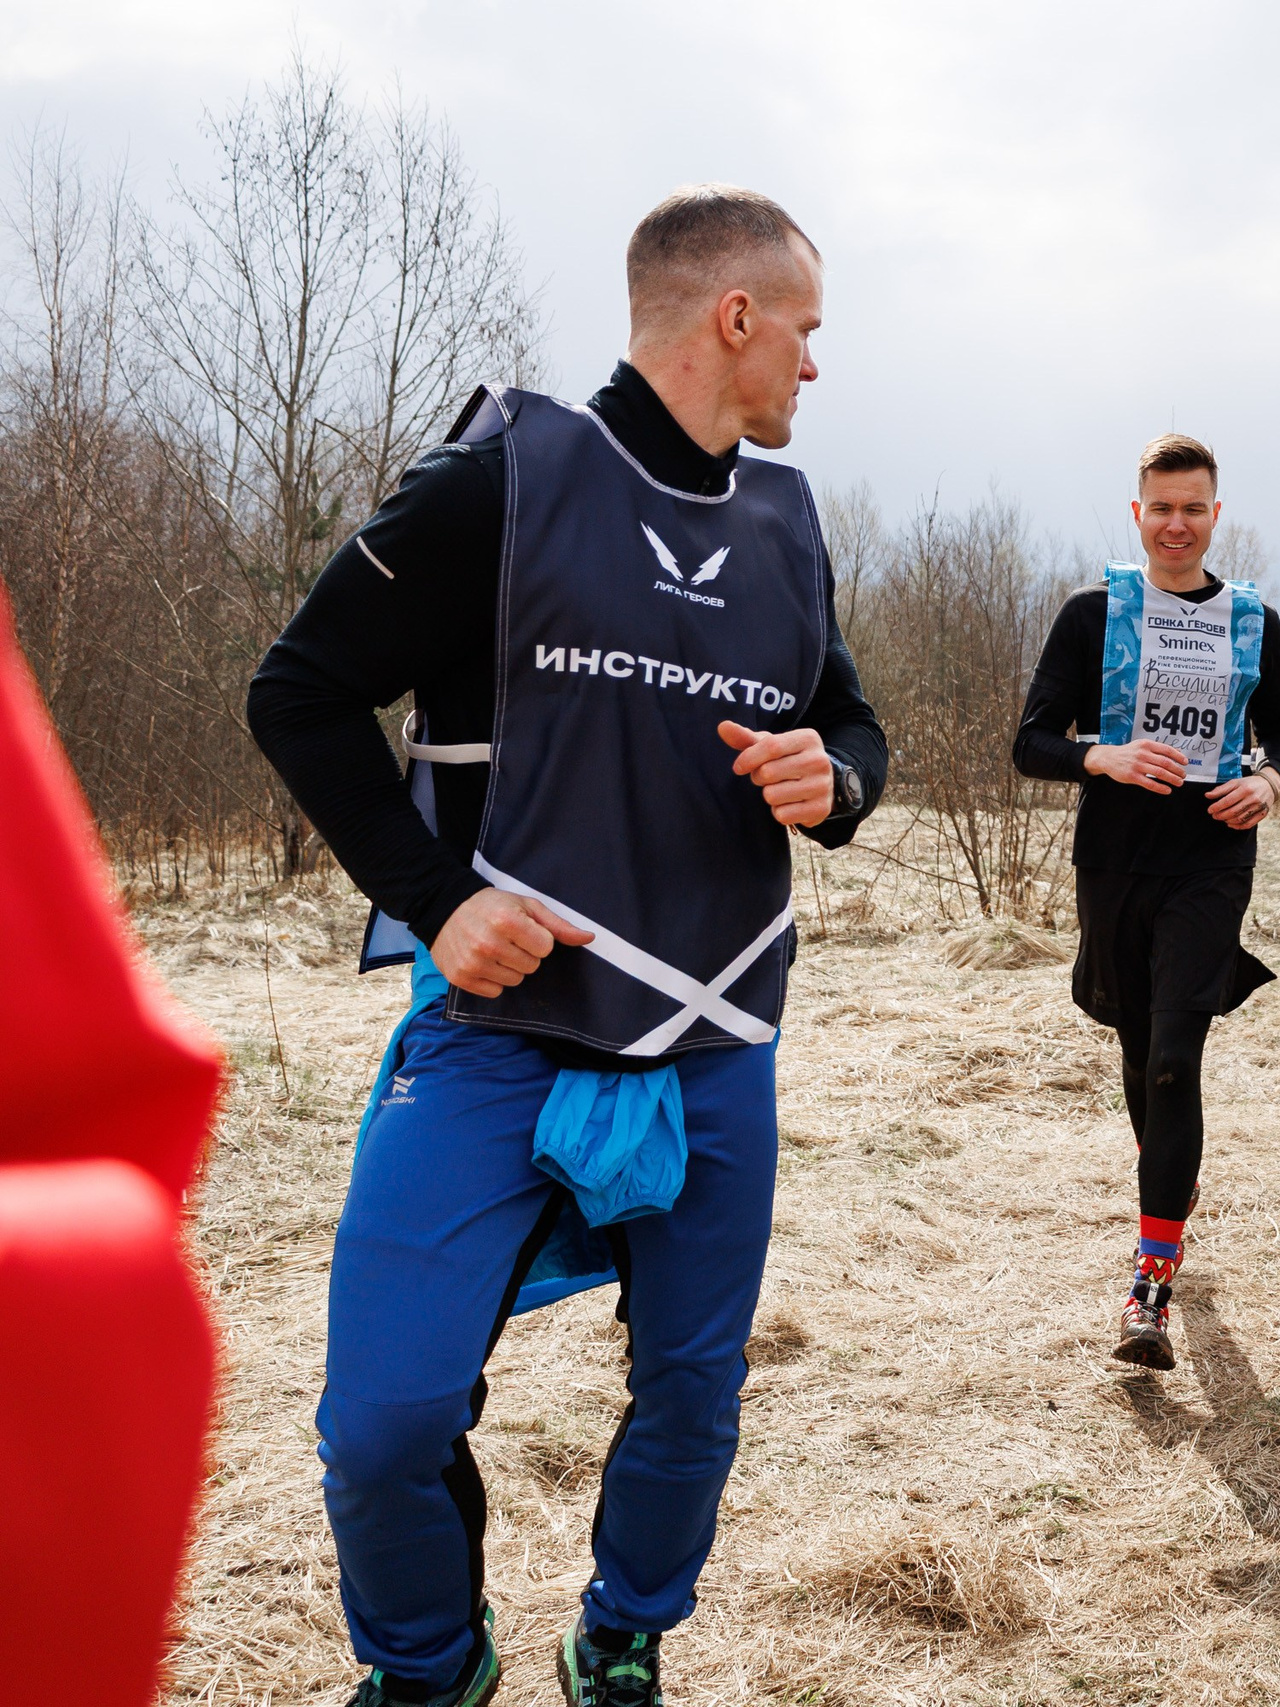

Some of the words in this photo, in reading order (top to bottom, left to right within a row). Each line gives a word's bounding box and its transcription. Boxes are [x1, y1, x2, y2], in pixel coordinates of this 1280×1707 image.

[654, 581, 682, 597] ЛИГА
[684, 590, 725, 608] ГЕРОЕВ
[1148, 617, 1184, 628] ГОНКА
[1188, 620, 1226, 634] ГЕРОЕВ
[1159, 634, 1215, 653] Sminex
[1158, 655, 1216, 665] ПЕРФЕКЦИОНИСТЫ
[1174, 664, 1216, 672] DEVELOPMENT
[536, 645, 796, 714] ИНСТРУКТОР
[1142, 702, 1218, 739] 5409
